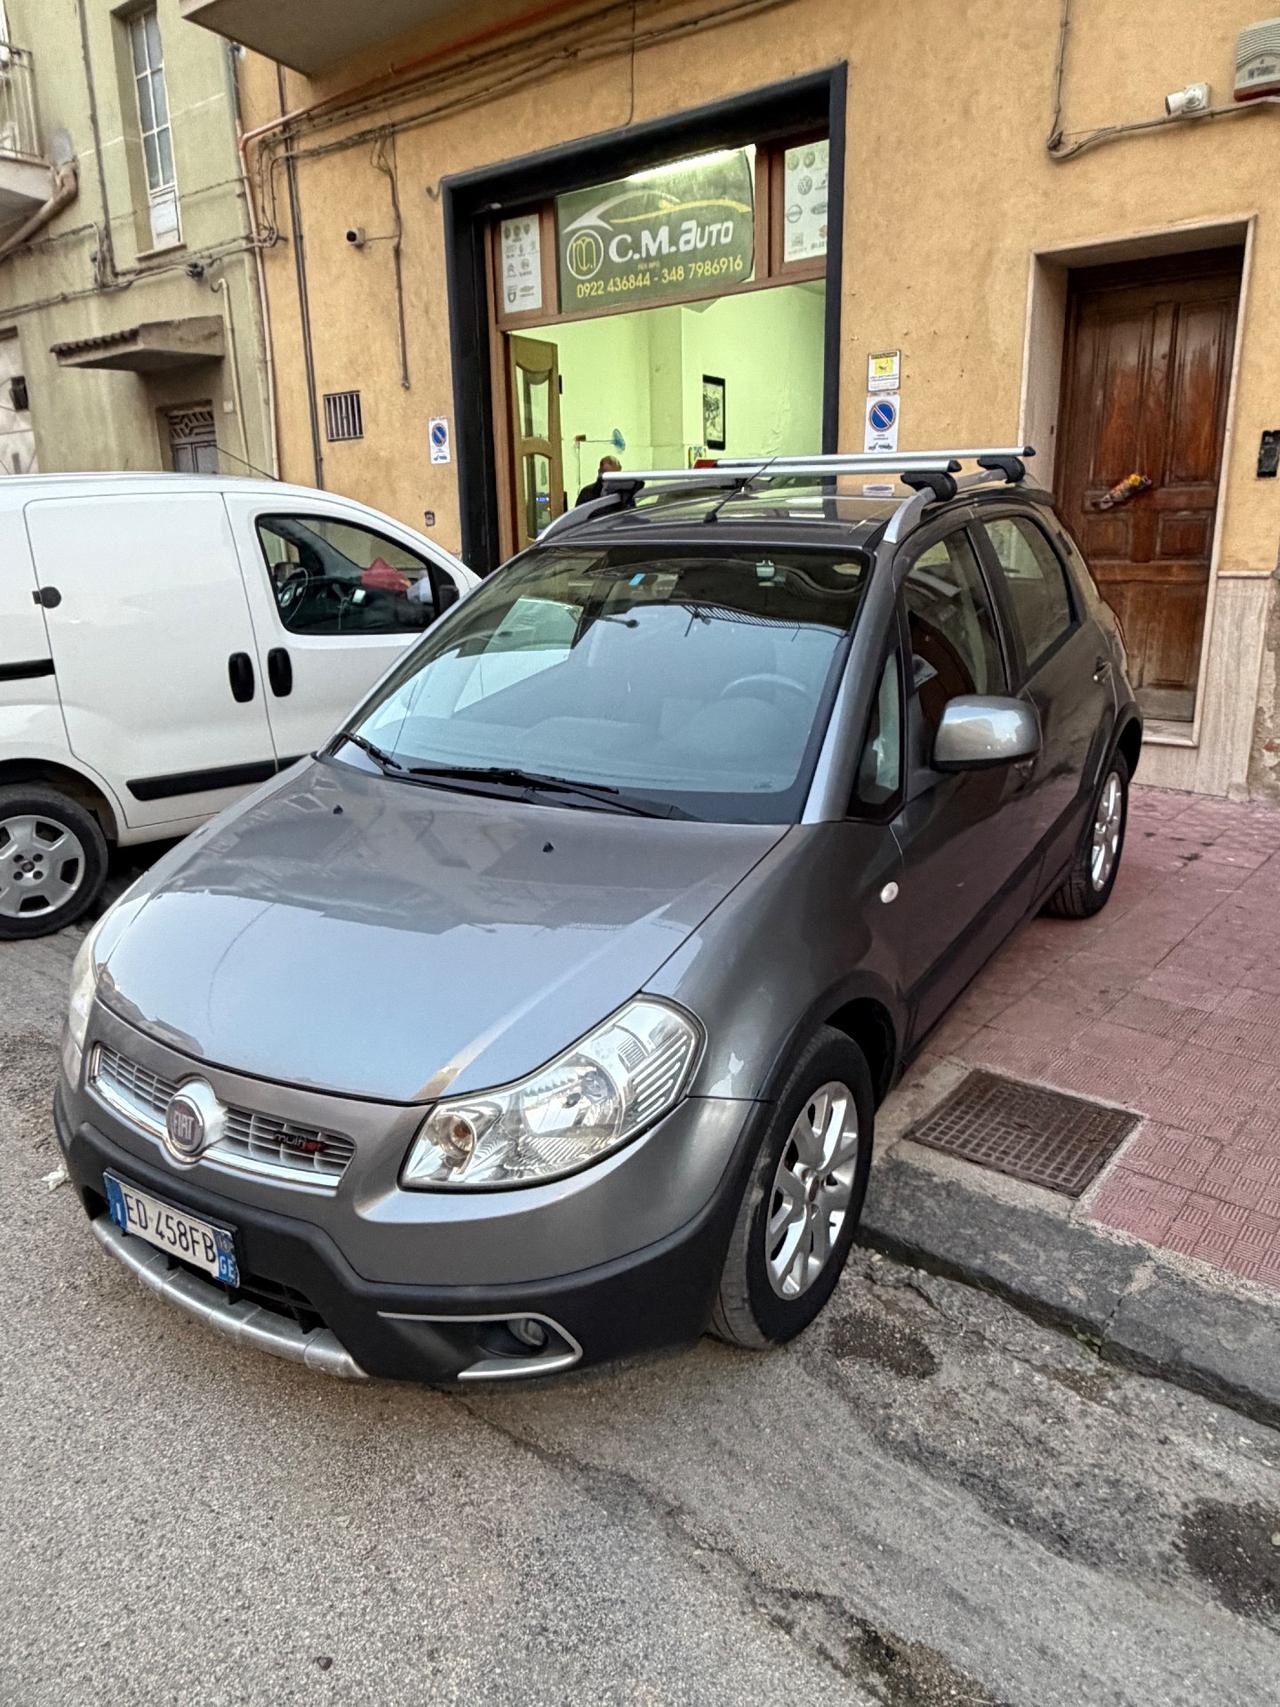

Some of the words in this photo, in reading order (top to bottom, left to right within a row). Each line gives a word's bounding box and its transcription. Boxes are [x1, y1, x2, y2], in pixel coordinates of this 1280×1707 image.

[576, 280, 604, 298] 0922
[607, 271, 650, 292] 436844
[661, 267, 685, 284] 348
[688, 254, 743, 279] 7986916
[173, 1110, 195, 1140] FIAT
